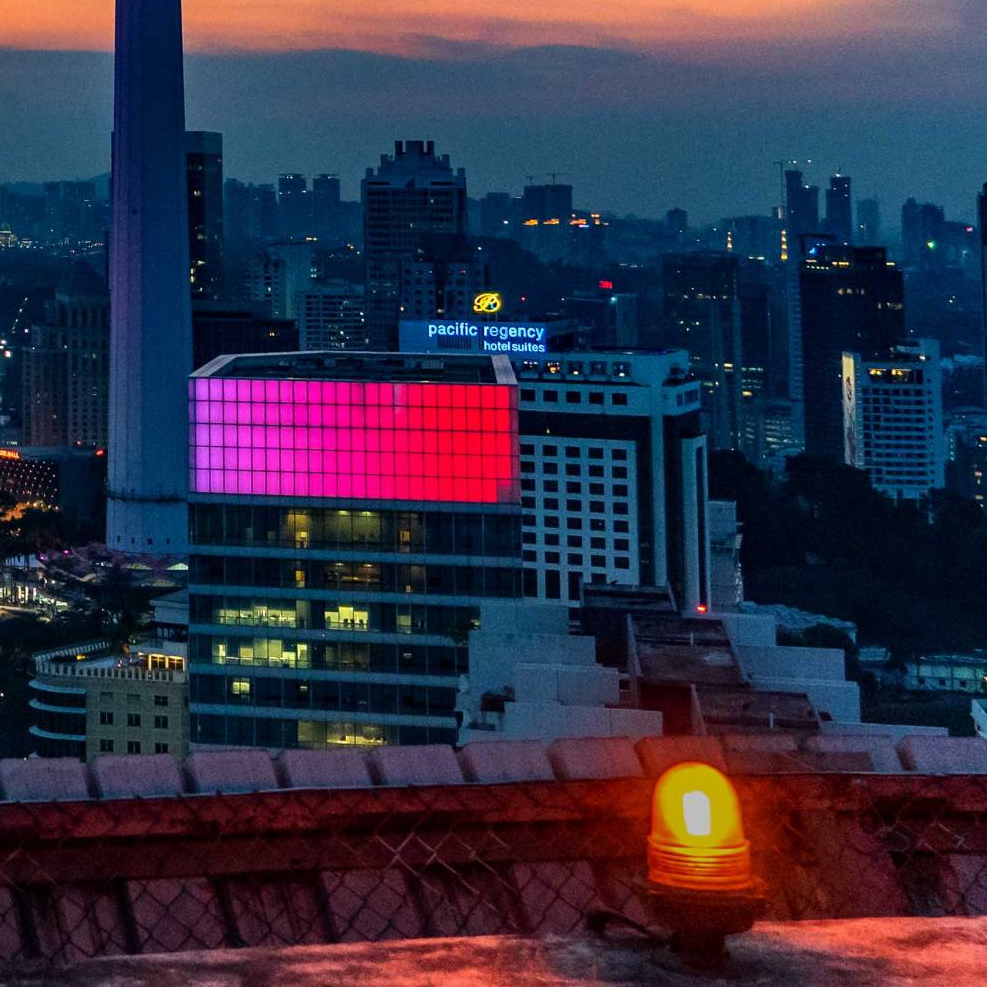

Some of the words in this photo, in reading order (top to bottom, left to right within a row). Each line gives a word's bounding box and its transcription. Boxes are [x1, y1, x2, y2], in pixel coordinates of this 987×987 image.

[428, 322, 478, 337] pacific
[483, 325, 545, 341] regency
[483, 340, 511, 351] hotel
[511, 342, 546, 352] suites
